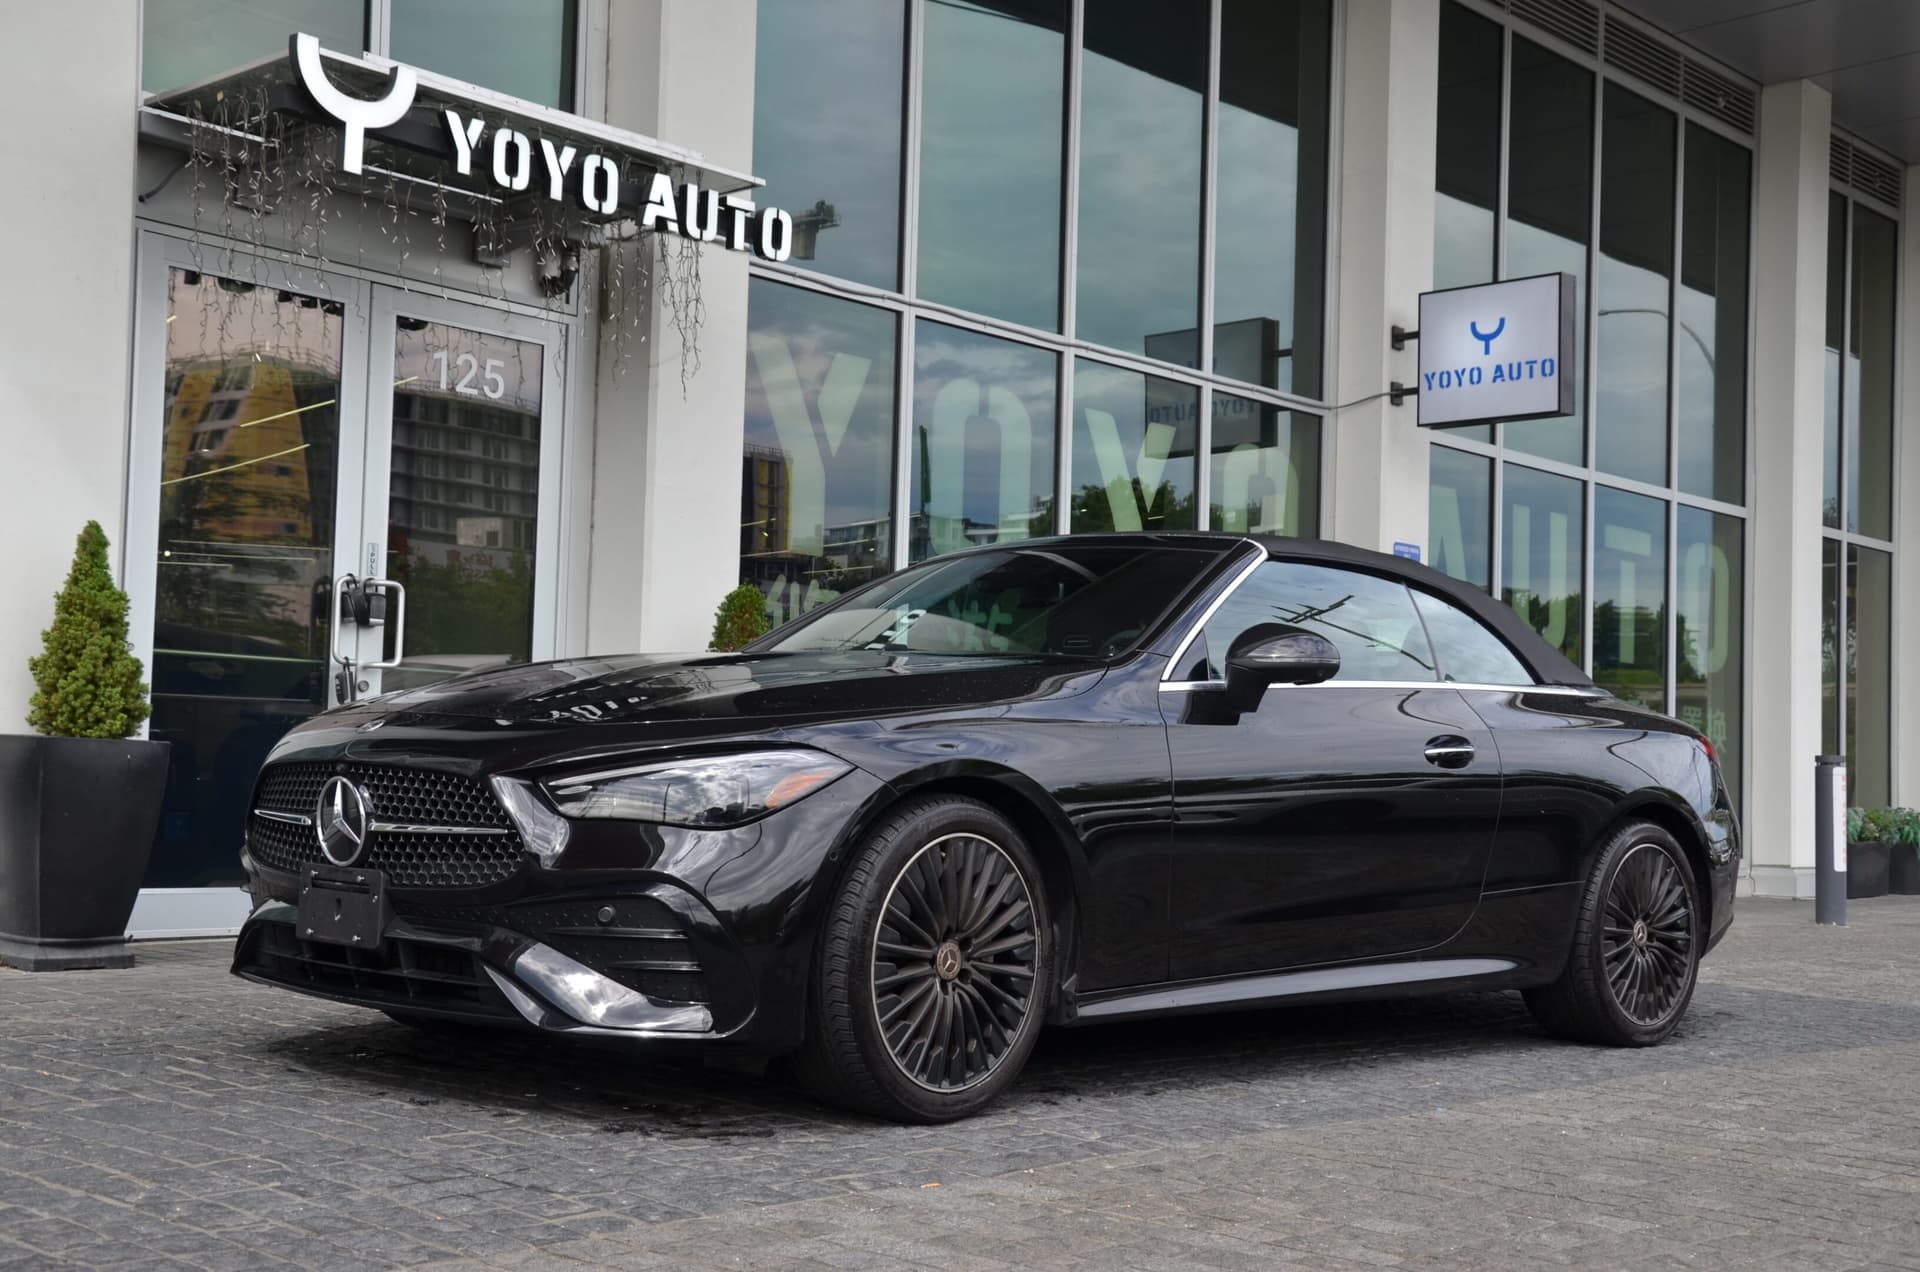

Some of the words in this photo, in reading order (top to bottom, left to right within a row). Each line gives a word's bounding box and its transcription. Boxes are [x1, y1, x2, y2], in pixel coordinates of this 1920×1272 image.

[445, 110, 619, 215] YOYO
[642, 172, 793, 262] AUTO
[433, 351, 505, 399] 125
[1424, 366, 1482, 391] YOYO
[1492, 358, 1555, 383] AUTO
